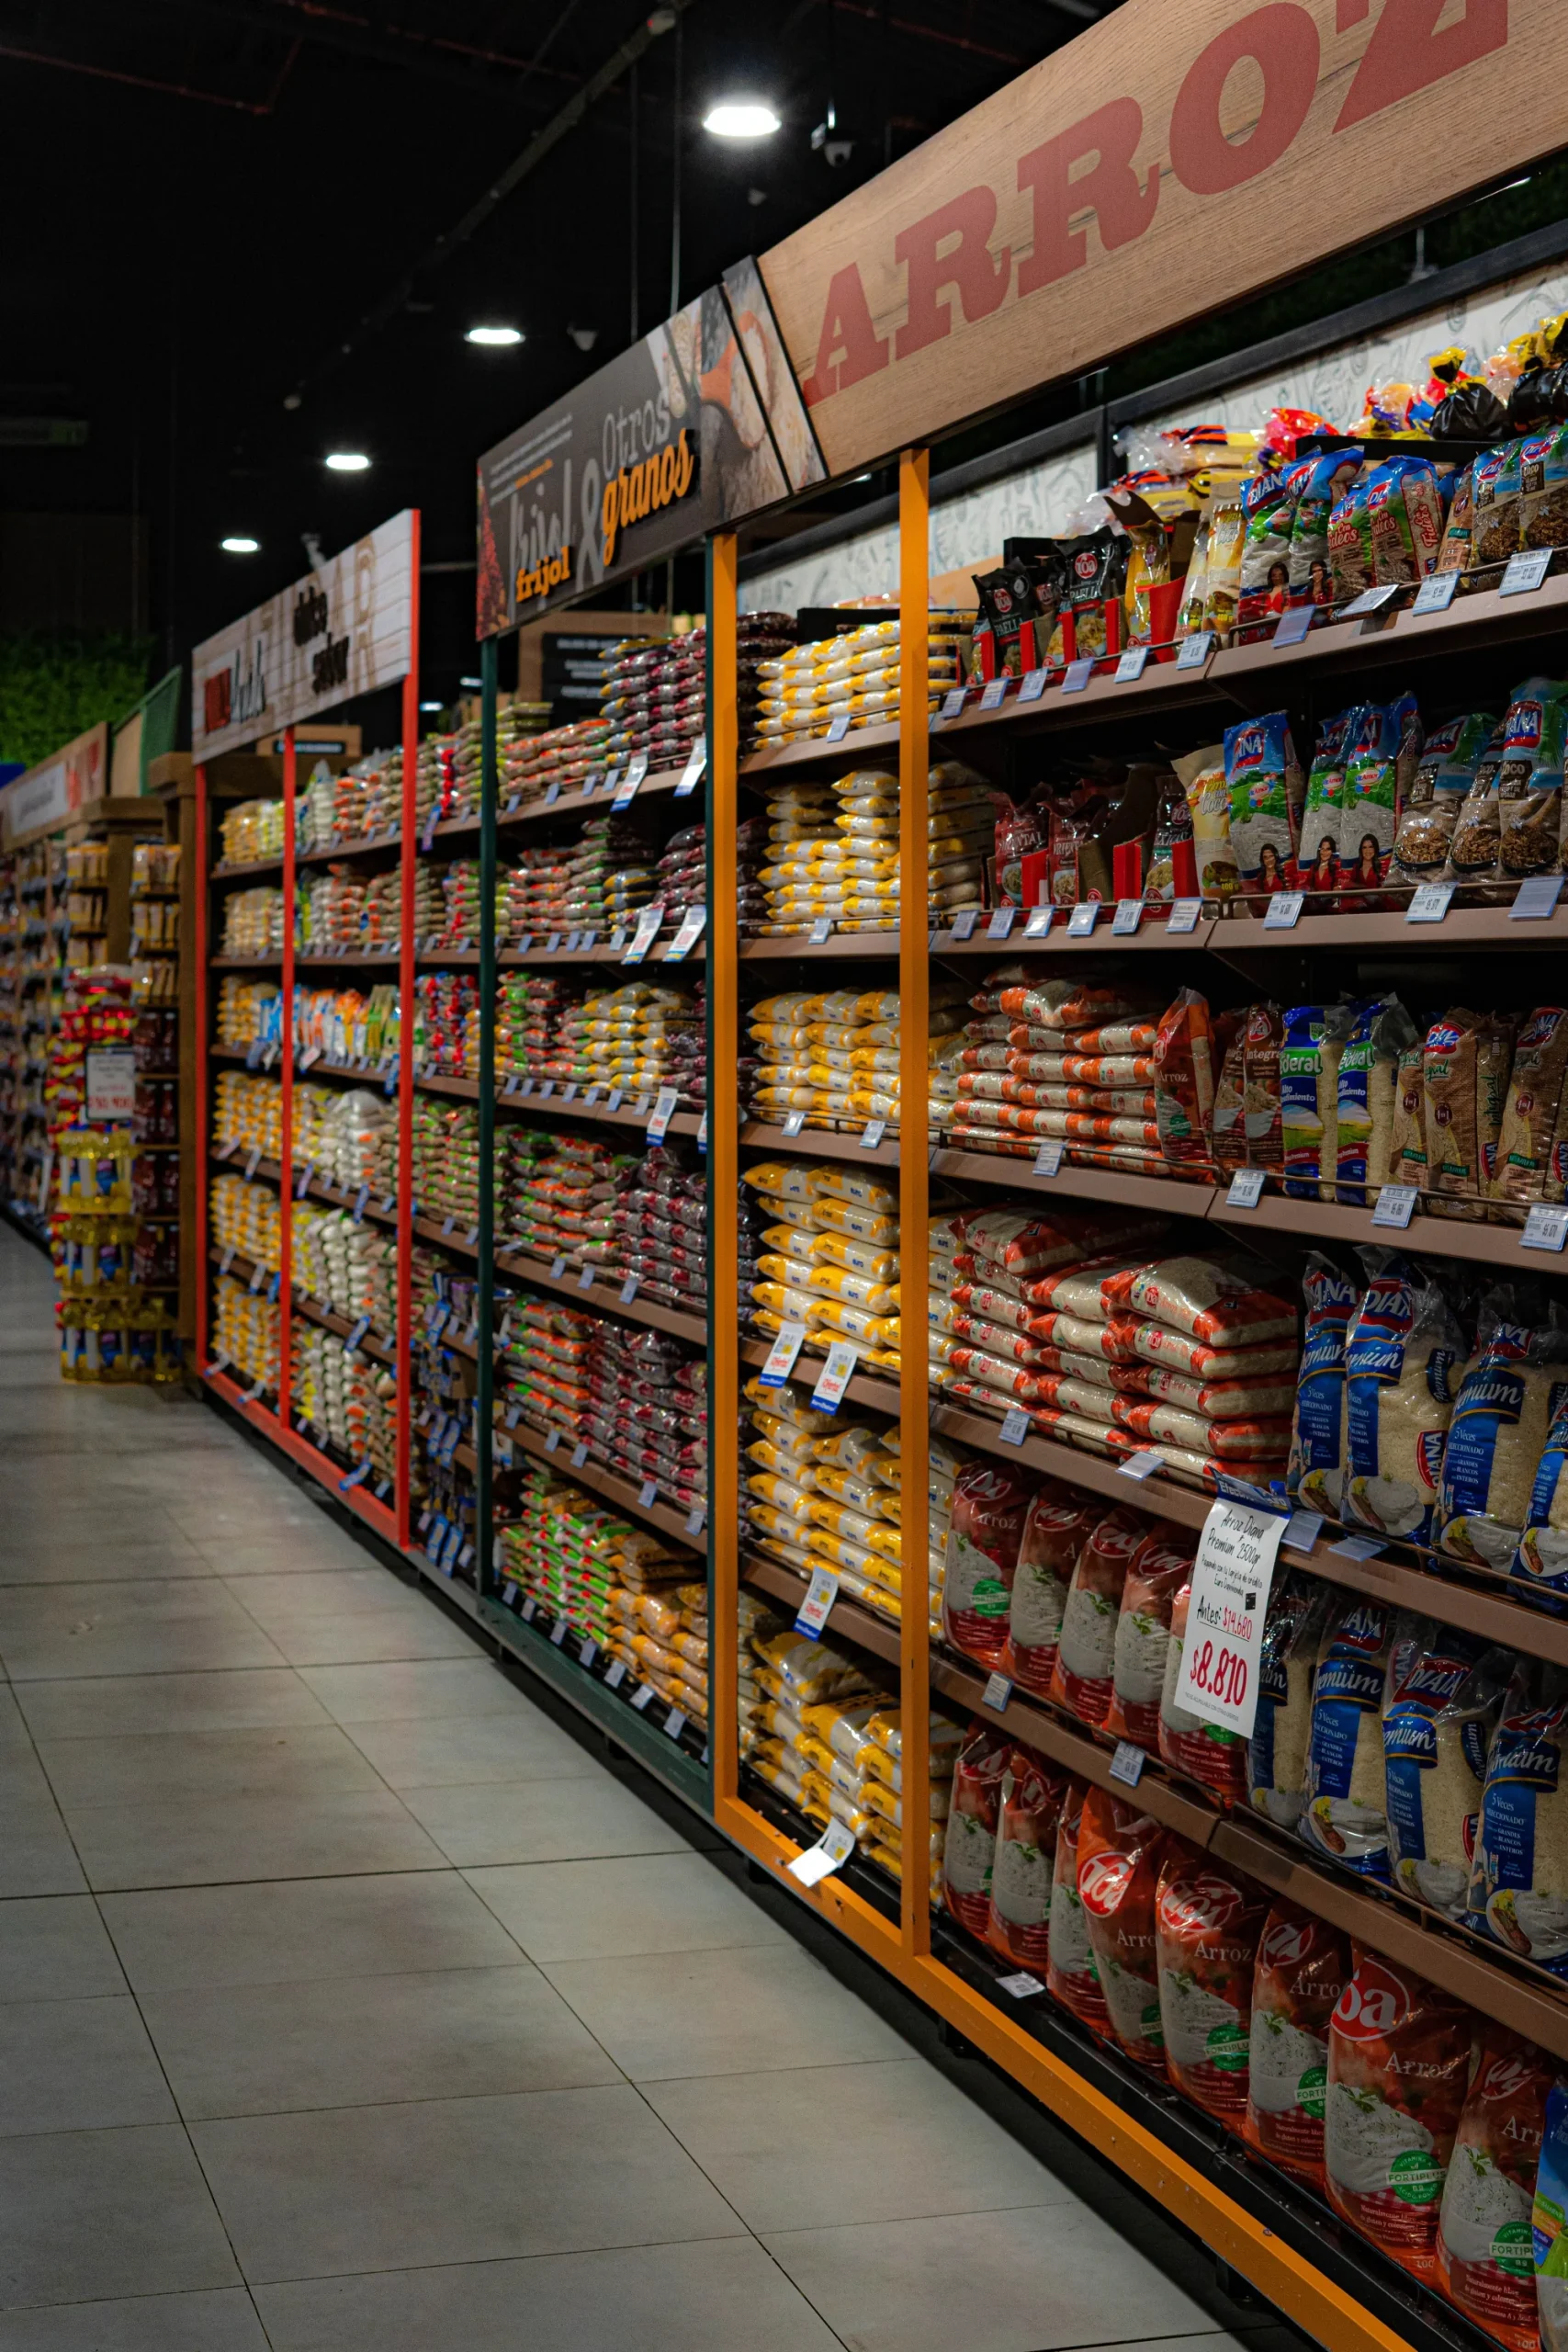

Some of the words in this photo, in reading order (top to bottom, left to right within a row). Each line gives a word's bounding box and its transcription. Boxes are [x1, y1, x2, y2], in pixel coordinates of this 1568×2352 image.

[603, 389, 671, 479] Otros
[602, 428, 695, 567] granos
[1337, 523, 1351, 535] Con
[516, 546, 570, 603] frijol
[1314, 1278, 1357, 1311] ANA
[1460, 1429, 1477, 1442] Veces
[1221, 1510, 1244, 1532] Arroz
[1207, 1528, 1235, 1556] Premium
[1214, 1573, 1224, 1588] Euro
[1197, 1595, 1222, 1625] Antes:
[1223, 1605, 1252, 1641] $14.680
[1190, 1640, 1247, 1706] $8.810
[1324, 1711, 1339, 1727] Veces
[1496, 1796, 1514, 1812] Veces
[1497, 1827, 1521, 1839] GRANDES
[1497, 1837, 1521, 1847] BLANCOS
[1499, 1844, 1523, 1856] ENTEROS
[1194, 1939, 1252, 1962] Arroz
[1290, 1975, 1341, 1999] Arro
[1205, 2041, 1249, 2055] FORTIPLU
[1383, 2051, 1454, 2080] Arroz
[1501, 2115, 1543, 2147] Arr
[1389, 2169, 1447, 2183] FORTIPLUS
[1492, 2245, 1533, 2256] FORTIP
